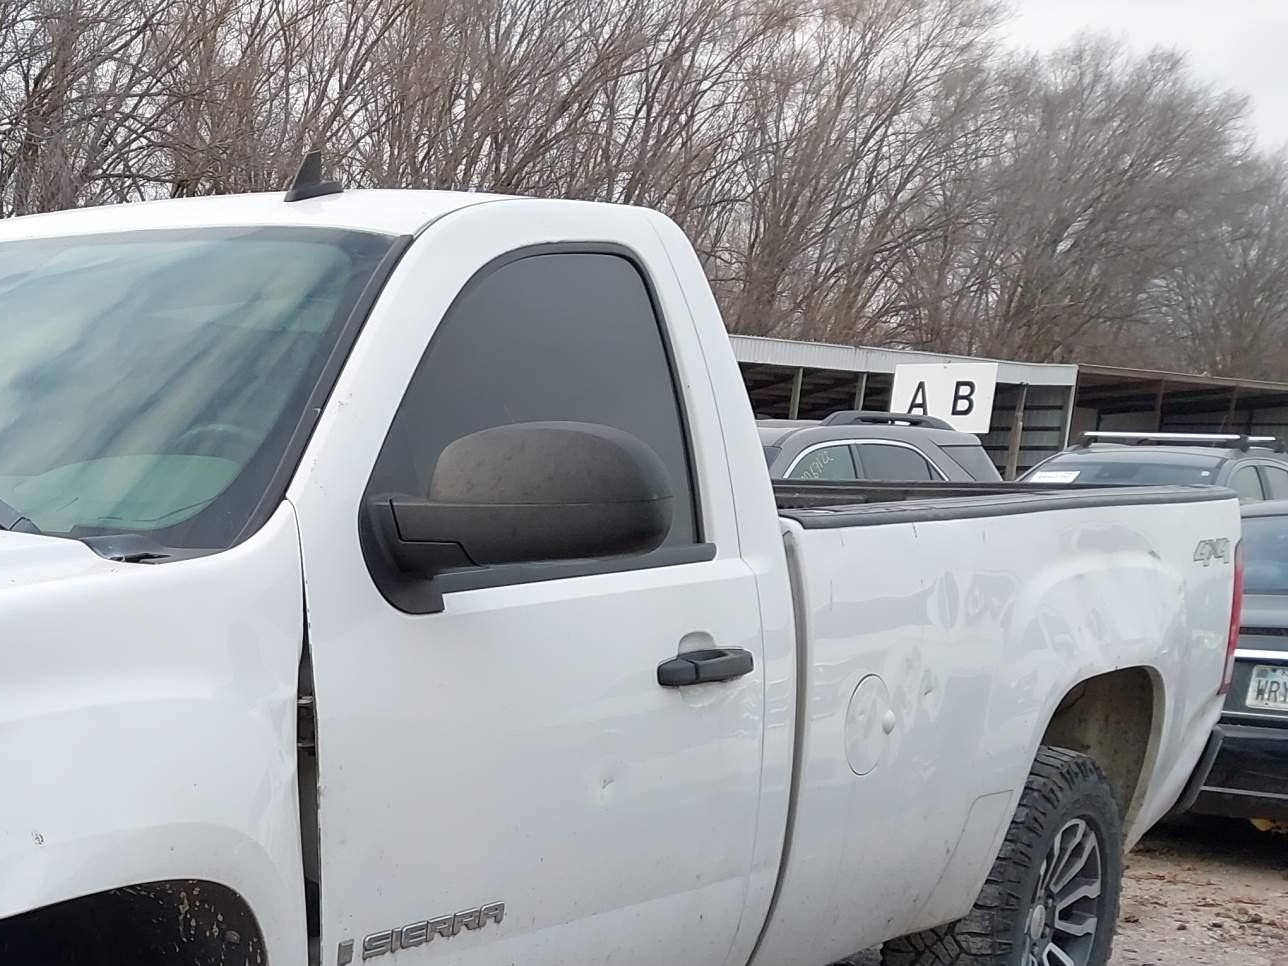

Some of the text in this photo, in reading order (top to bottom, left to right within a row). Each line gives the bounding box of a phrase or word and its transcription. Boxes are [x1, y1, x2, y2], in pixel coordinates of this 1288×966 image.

[907, 381, 976, 416] A B
[362, 900, 505, 961] SIERRA
